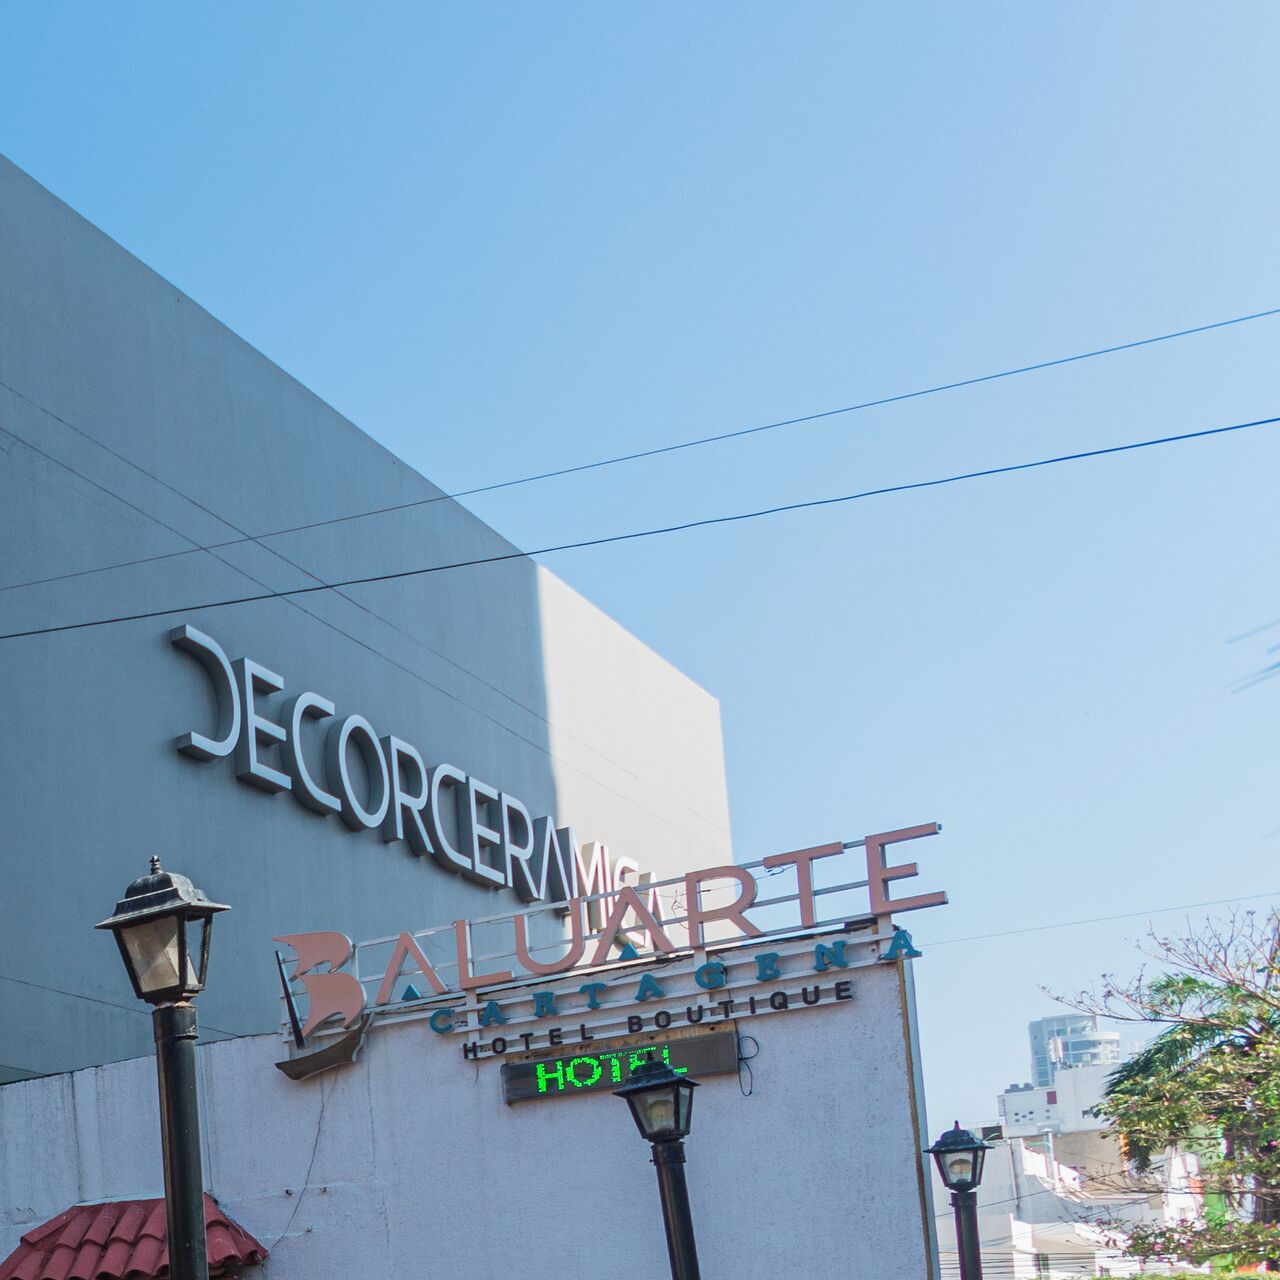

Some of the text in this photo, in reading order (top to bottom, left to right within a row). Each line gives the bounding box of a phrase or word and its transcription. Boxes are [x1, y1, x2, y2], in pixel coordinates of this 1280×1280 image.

[273, 823, 948, 1040] BALUARTE
[429, 929, 919, 1034] CARTAGENA
[463, 981, 853, 1060] HOTEL BOUTIQUE
